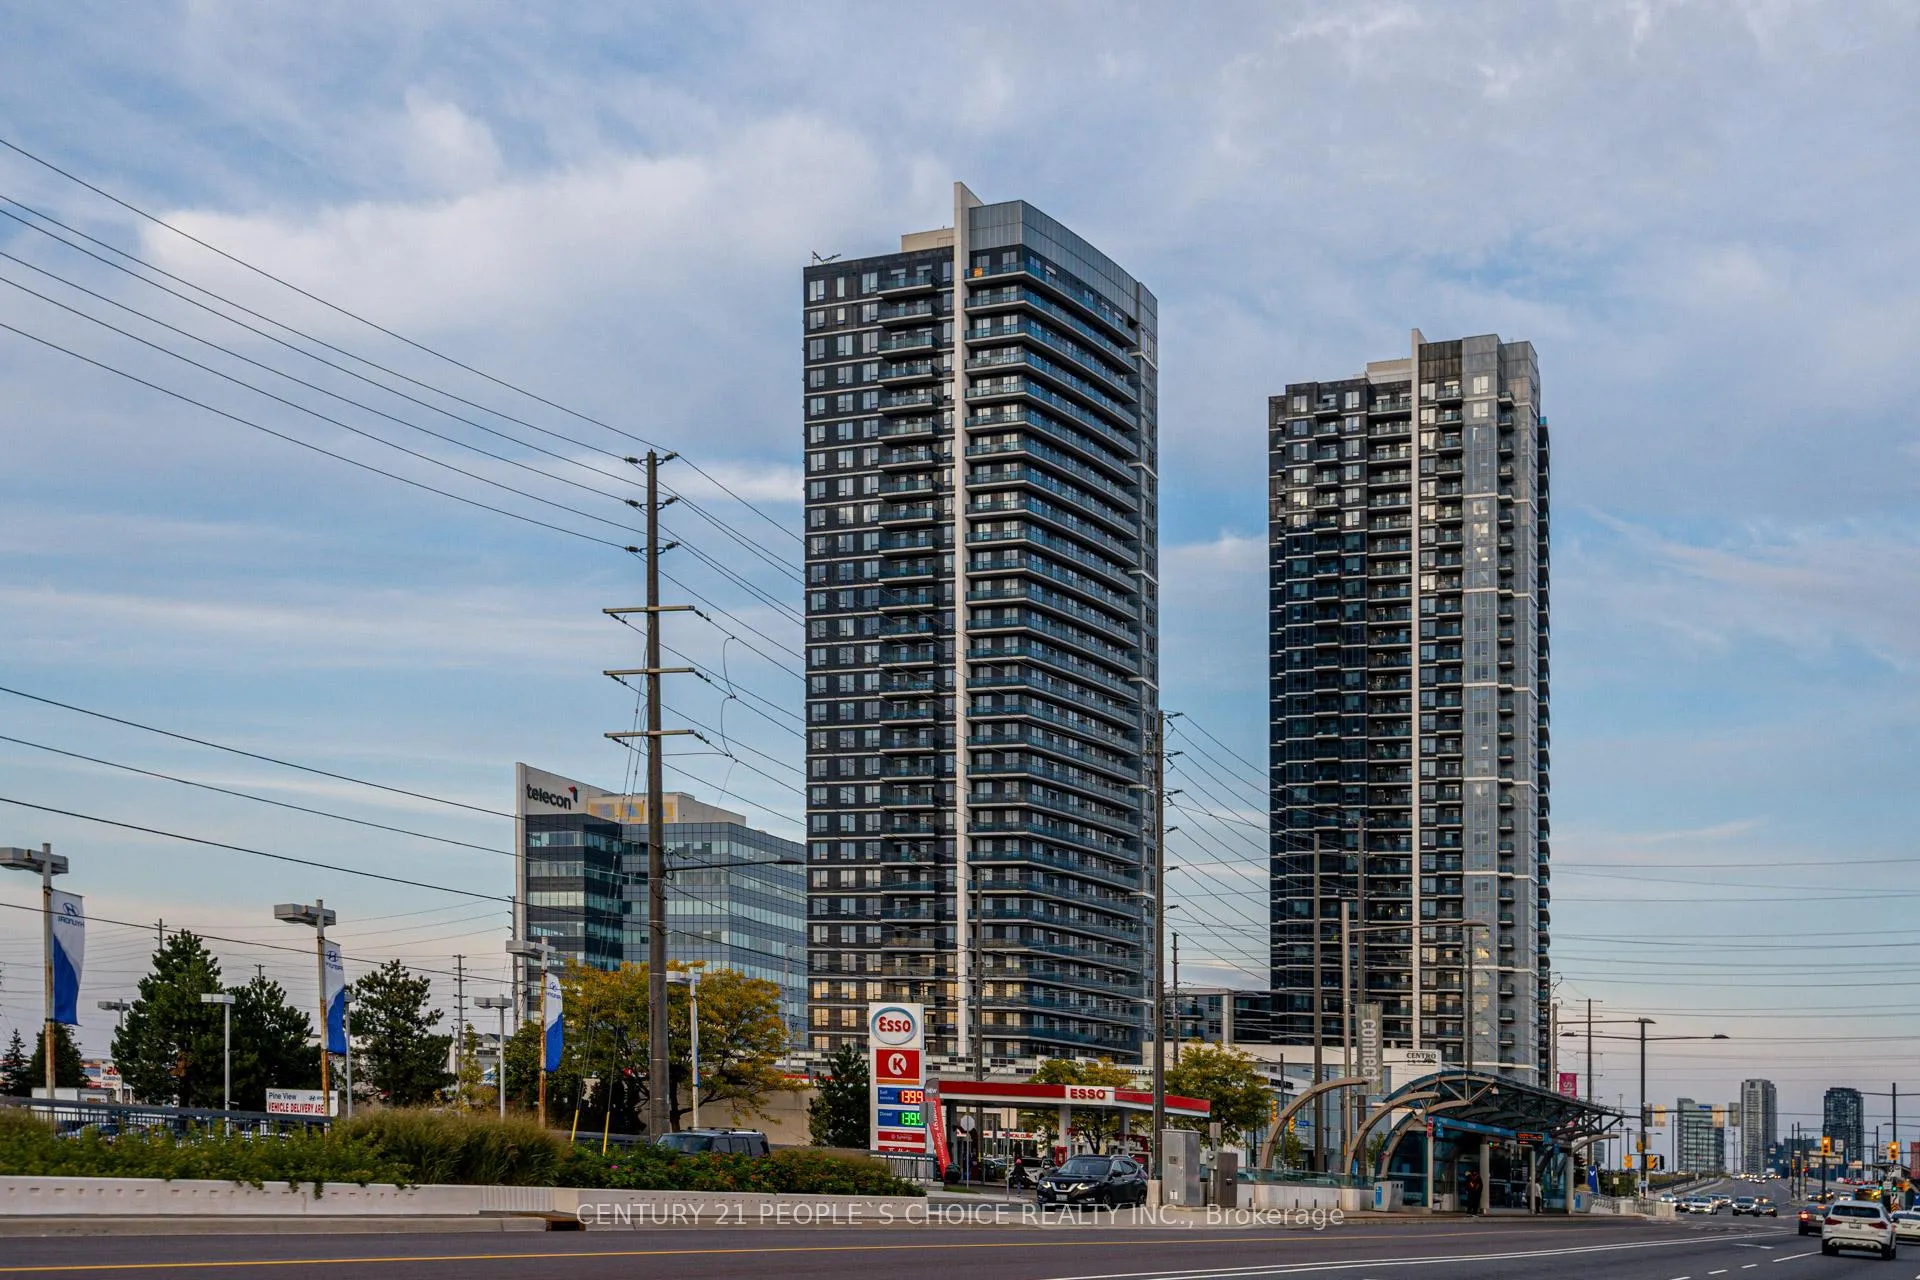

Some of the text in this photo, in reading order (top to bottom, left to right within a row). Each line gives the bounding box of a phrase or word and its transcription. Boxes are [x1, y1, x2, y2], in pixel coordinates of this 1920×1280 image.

[527, 783, 572, 811] telecon
[878, 1016, 911, 1033] Esso
[1361, 1019, 1381, 1082] connect
[1406, 1052, 1437, 1060] CENTRO
[892, 1057, 906, 1073] K
[1070, 1088, 1106, 1100] ESSO
[268, 1102, 289, 1113] VEHICLE
[290, 1103, 314, 1114] DELIVERY
